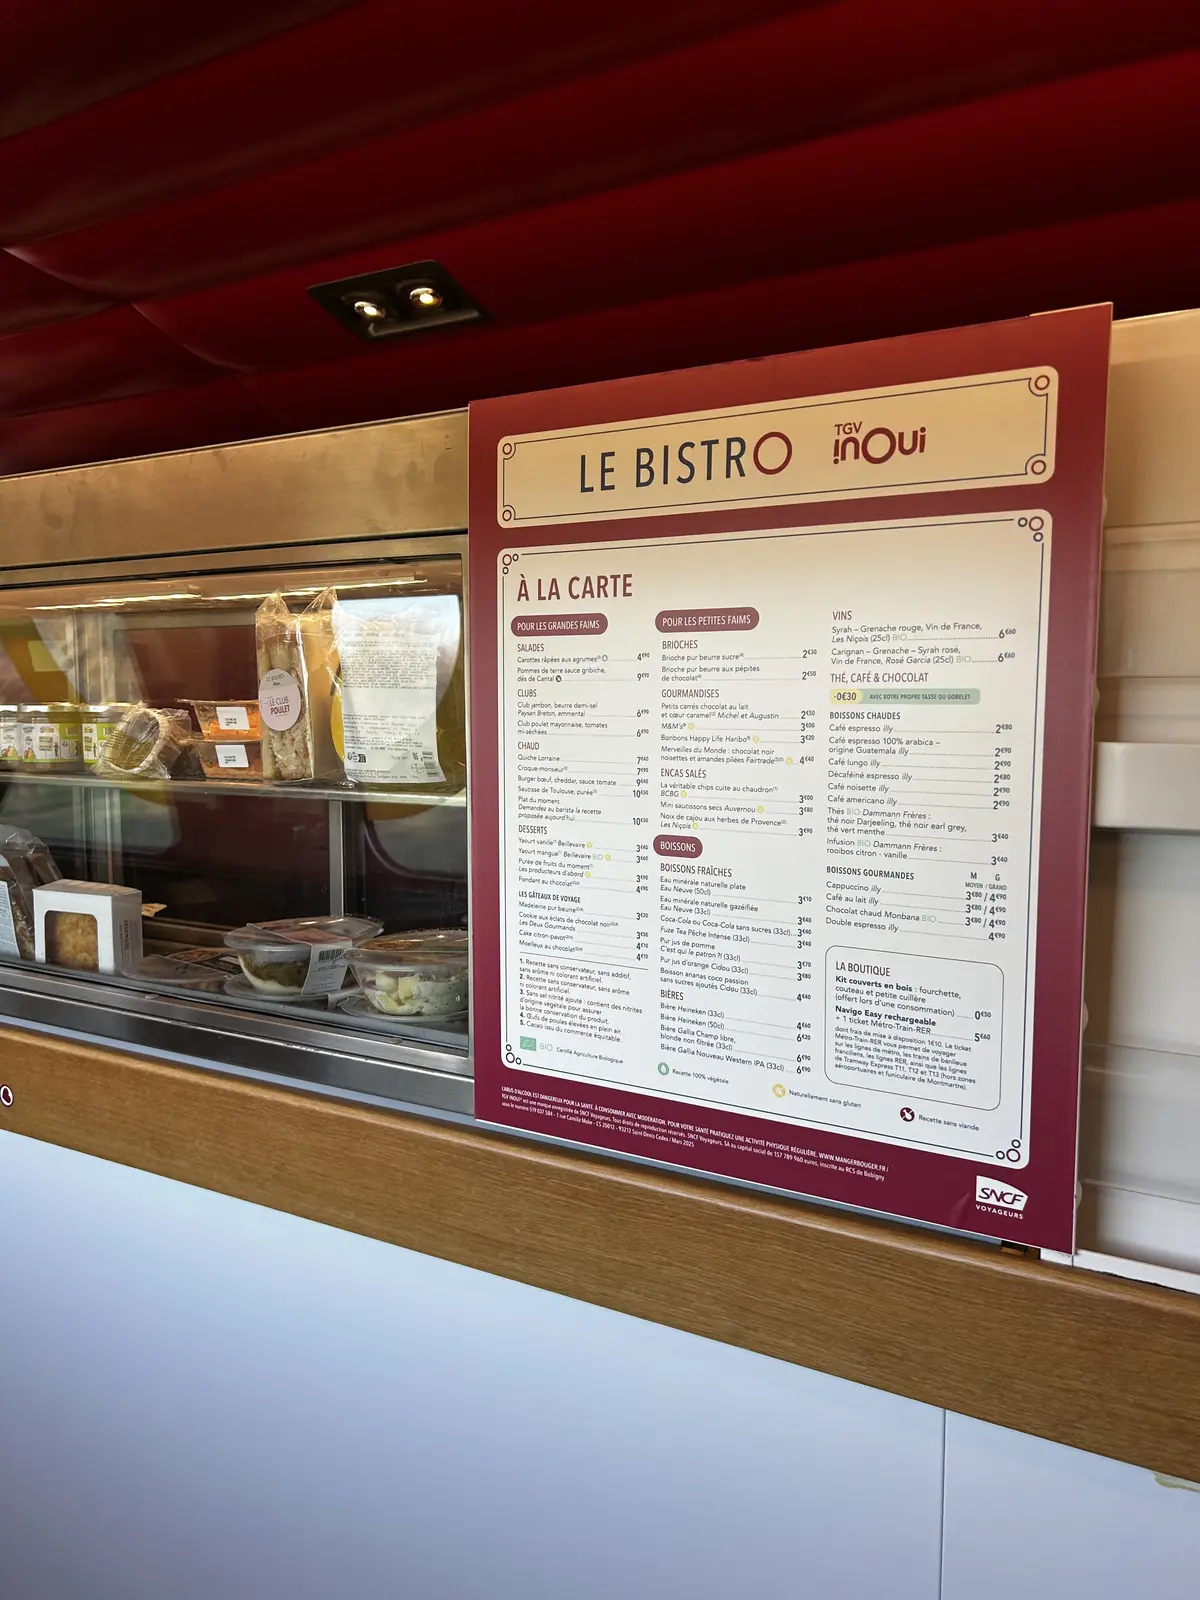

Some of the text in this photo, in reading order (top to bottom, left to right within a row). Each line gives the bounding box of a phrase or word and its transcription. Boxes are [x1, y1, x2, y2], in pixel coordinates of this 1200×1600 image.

[834, 421, 862, 435] TGV
[580, 431, 792, 492] LE BISTRO
[517, 573, 632, 601] À LA CARTE
[662, 614, 750, 626] POUR LES PETITES FAIMS
[832, 610, 851, 620] VINS
[517, 620, 599, 630] POUR LES GRANDES FAIMS
[832, 625, 851, 635] Syrah
[860, 624, 896, 632] Grenache
[940, 622, 950, 630] de
[662, 639, 697, 649] BRIOCHES
[846, 635, 868, 643] Niçois
[870, 634, 890, 642] (25cl)
[892, 633, 906, 641] BIO
[517, 643, 544, 652] SALADES
[734, 664, 759, 673] pépites
[830, 670, 928, 683] THÉ, CAFÉ & CHOCOLAT
[517, 688, 536, 697] CLUBS
[661, 688, 719, 697] GOURMANDISES
[270, 705, 290, 715] POULET
[700, 702, 727, 710] chocolat
[829, 711, 900, 719] BOISSONS CHAUDES
[829, 723, 846, 731] Café
[882, 724, 893, 733] illy
[517, 741, 539, 750] CHAUD
[828, 757, 845, 765] Café
[847, 758, 867, 767] lungo
[870, 759, 880, 768] illy
[660, 767, 706, 778] ENCAS SALÉS
[828, 770, 864, 778] Décaféiné
[901, 772, 912, 781] illy
[518, 824, 547, 834] DESSERTS
[660, 841, 695, 851] BOISSONS
[660, 862, 732, 877] BOISSONS FRAÎCHES
[826, 865, 914, 880] BOISSONS GOURMANDES
[826, 880, 868, 891] Cappuccino
[871, 884, 880, 894] illy
[528, 890, 550, 899] GÂTEAUX
[560, 895, 580, 903] VOYAGE
[825, 904, 919, 920] Chocolat chaud Monbana
[660, 914, 691, 924] Coca-Cola
[702, 919, 734, 929] Coca-Cola
[772, 927, 790, 936] (33cl)
[825, 916, 851, 926] Double
[853, 921, 886, 929] espresso
[888, 923, 898, 932] illy
[835, 961, 890, 976] LA BOUTIQUE
[835, 975, 846, 983] Kit
[848, 978, 882, 987] couverts
[895, 982, 912, 991] bois
[919, 985, 960, 999] fourchette,
[660, 988, 683, 1000] BIÈRES
[660, 1002, 676, 1010] Bière
[677, 1005, 706, 1014] Heineken
[707, 1009, 724, 1018] (33cl)
[835, 1005, 936, 1026] Navigo Easy rechargeable
[660, 1013, 675, 1021] Bière
[677, 1016, 706, 1026] Heineken
[707, 1020, 724, 1030] (50cl)
[848, 1016, 868, 1025] ticket
[870, 1019, 931, 1034] Métro-Train-RER
[918, 1114, 942, 1124] Recette
[958, 1122, 979, 1130] viande
[818, 1152, 884, 1171] WWW.MANGERBOUGER.FR
[978, 1187, 1023, 1204] SNCF
[975, 1204, 1022, 1219] VOYAGEURS
